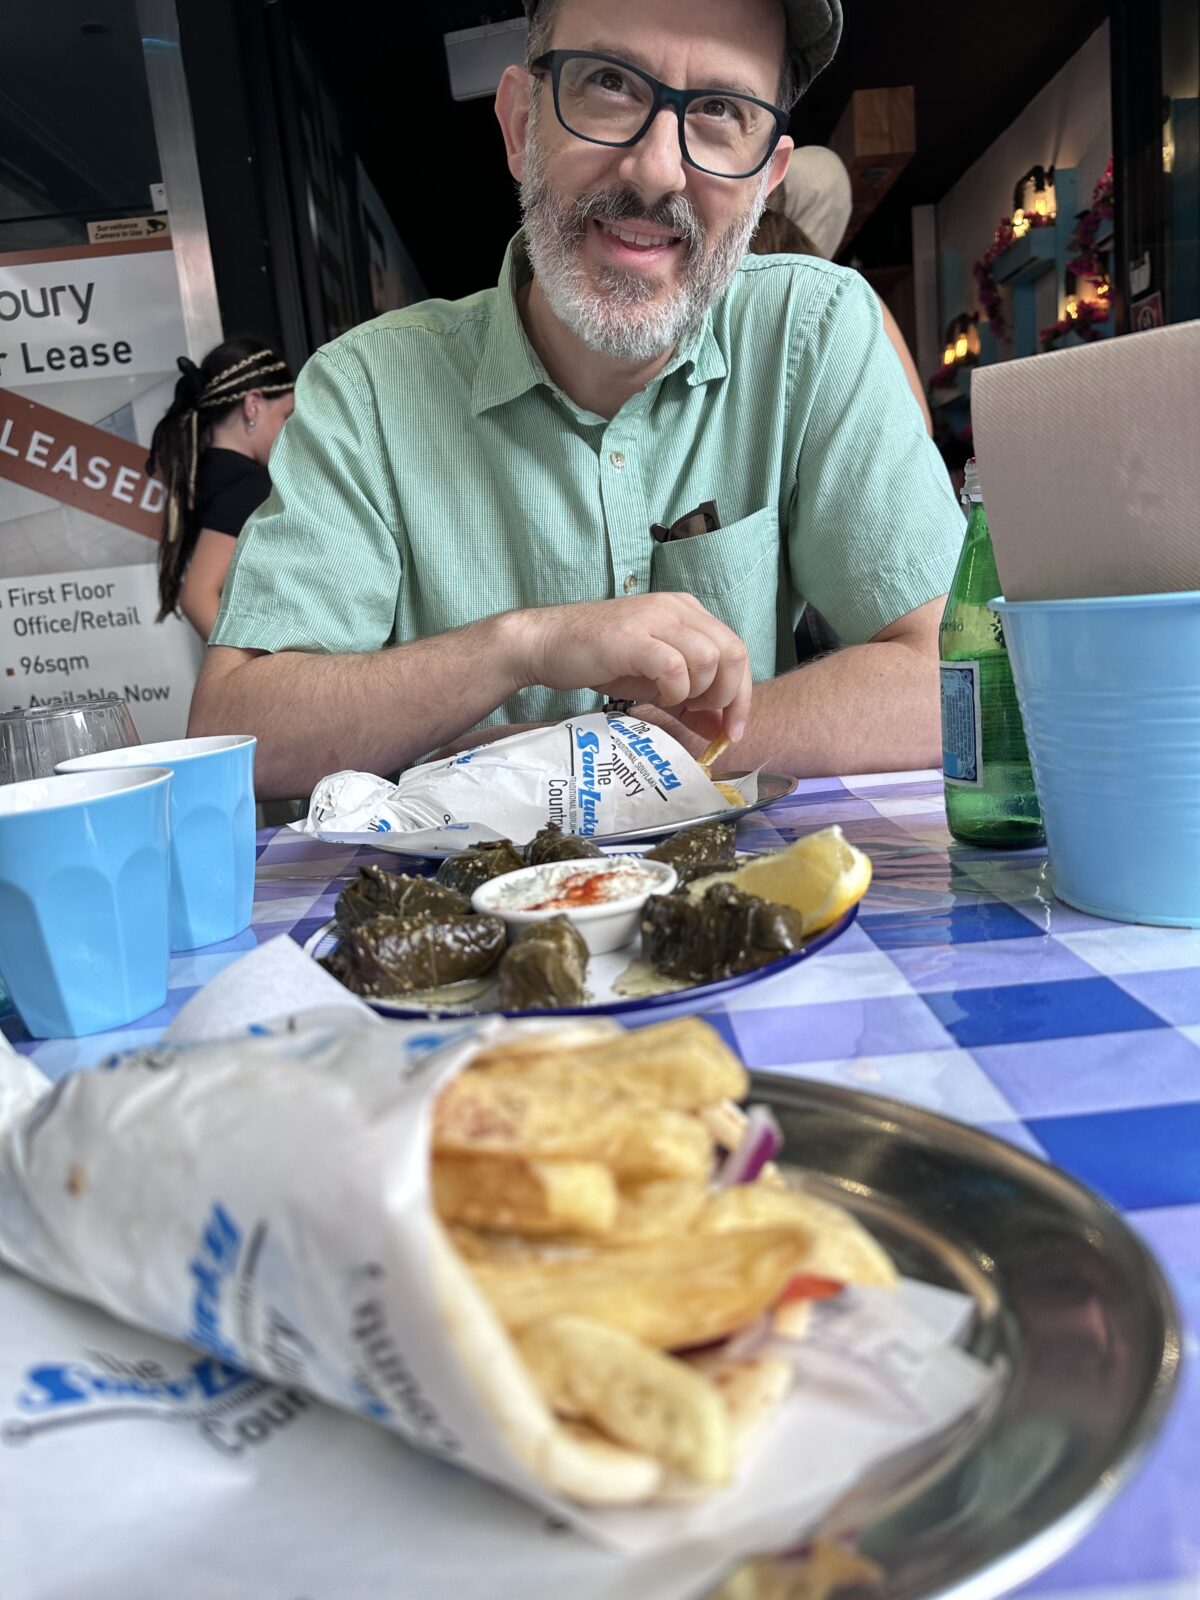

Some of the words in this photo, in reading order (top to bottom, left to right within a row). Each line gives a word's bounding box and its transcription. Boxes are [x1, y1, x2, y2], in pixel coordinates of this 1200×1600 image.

[95, 230, 120, 240] Camera
[129, 229, 143, 237] Use
[96, 222, 139, 232] Surveillance
[21, 341, 132, 374] Lease
[0, 418, 168, 513] LEASED
[8, 587, 57, 608] First
[61, 582, 115, 602] Floor
[13, 606, 141, 636] Office/Retail
[20, 655, 89, 675] 96sqm
[124, 683, 170, 702] Now
[628, 721, 650, 734] The
[597, 761, 613, 786] The
[614, 737, 638, 765] TRADITIONAL
[634, 761, 657, 788] SOUVLAKI
